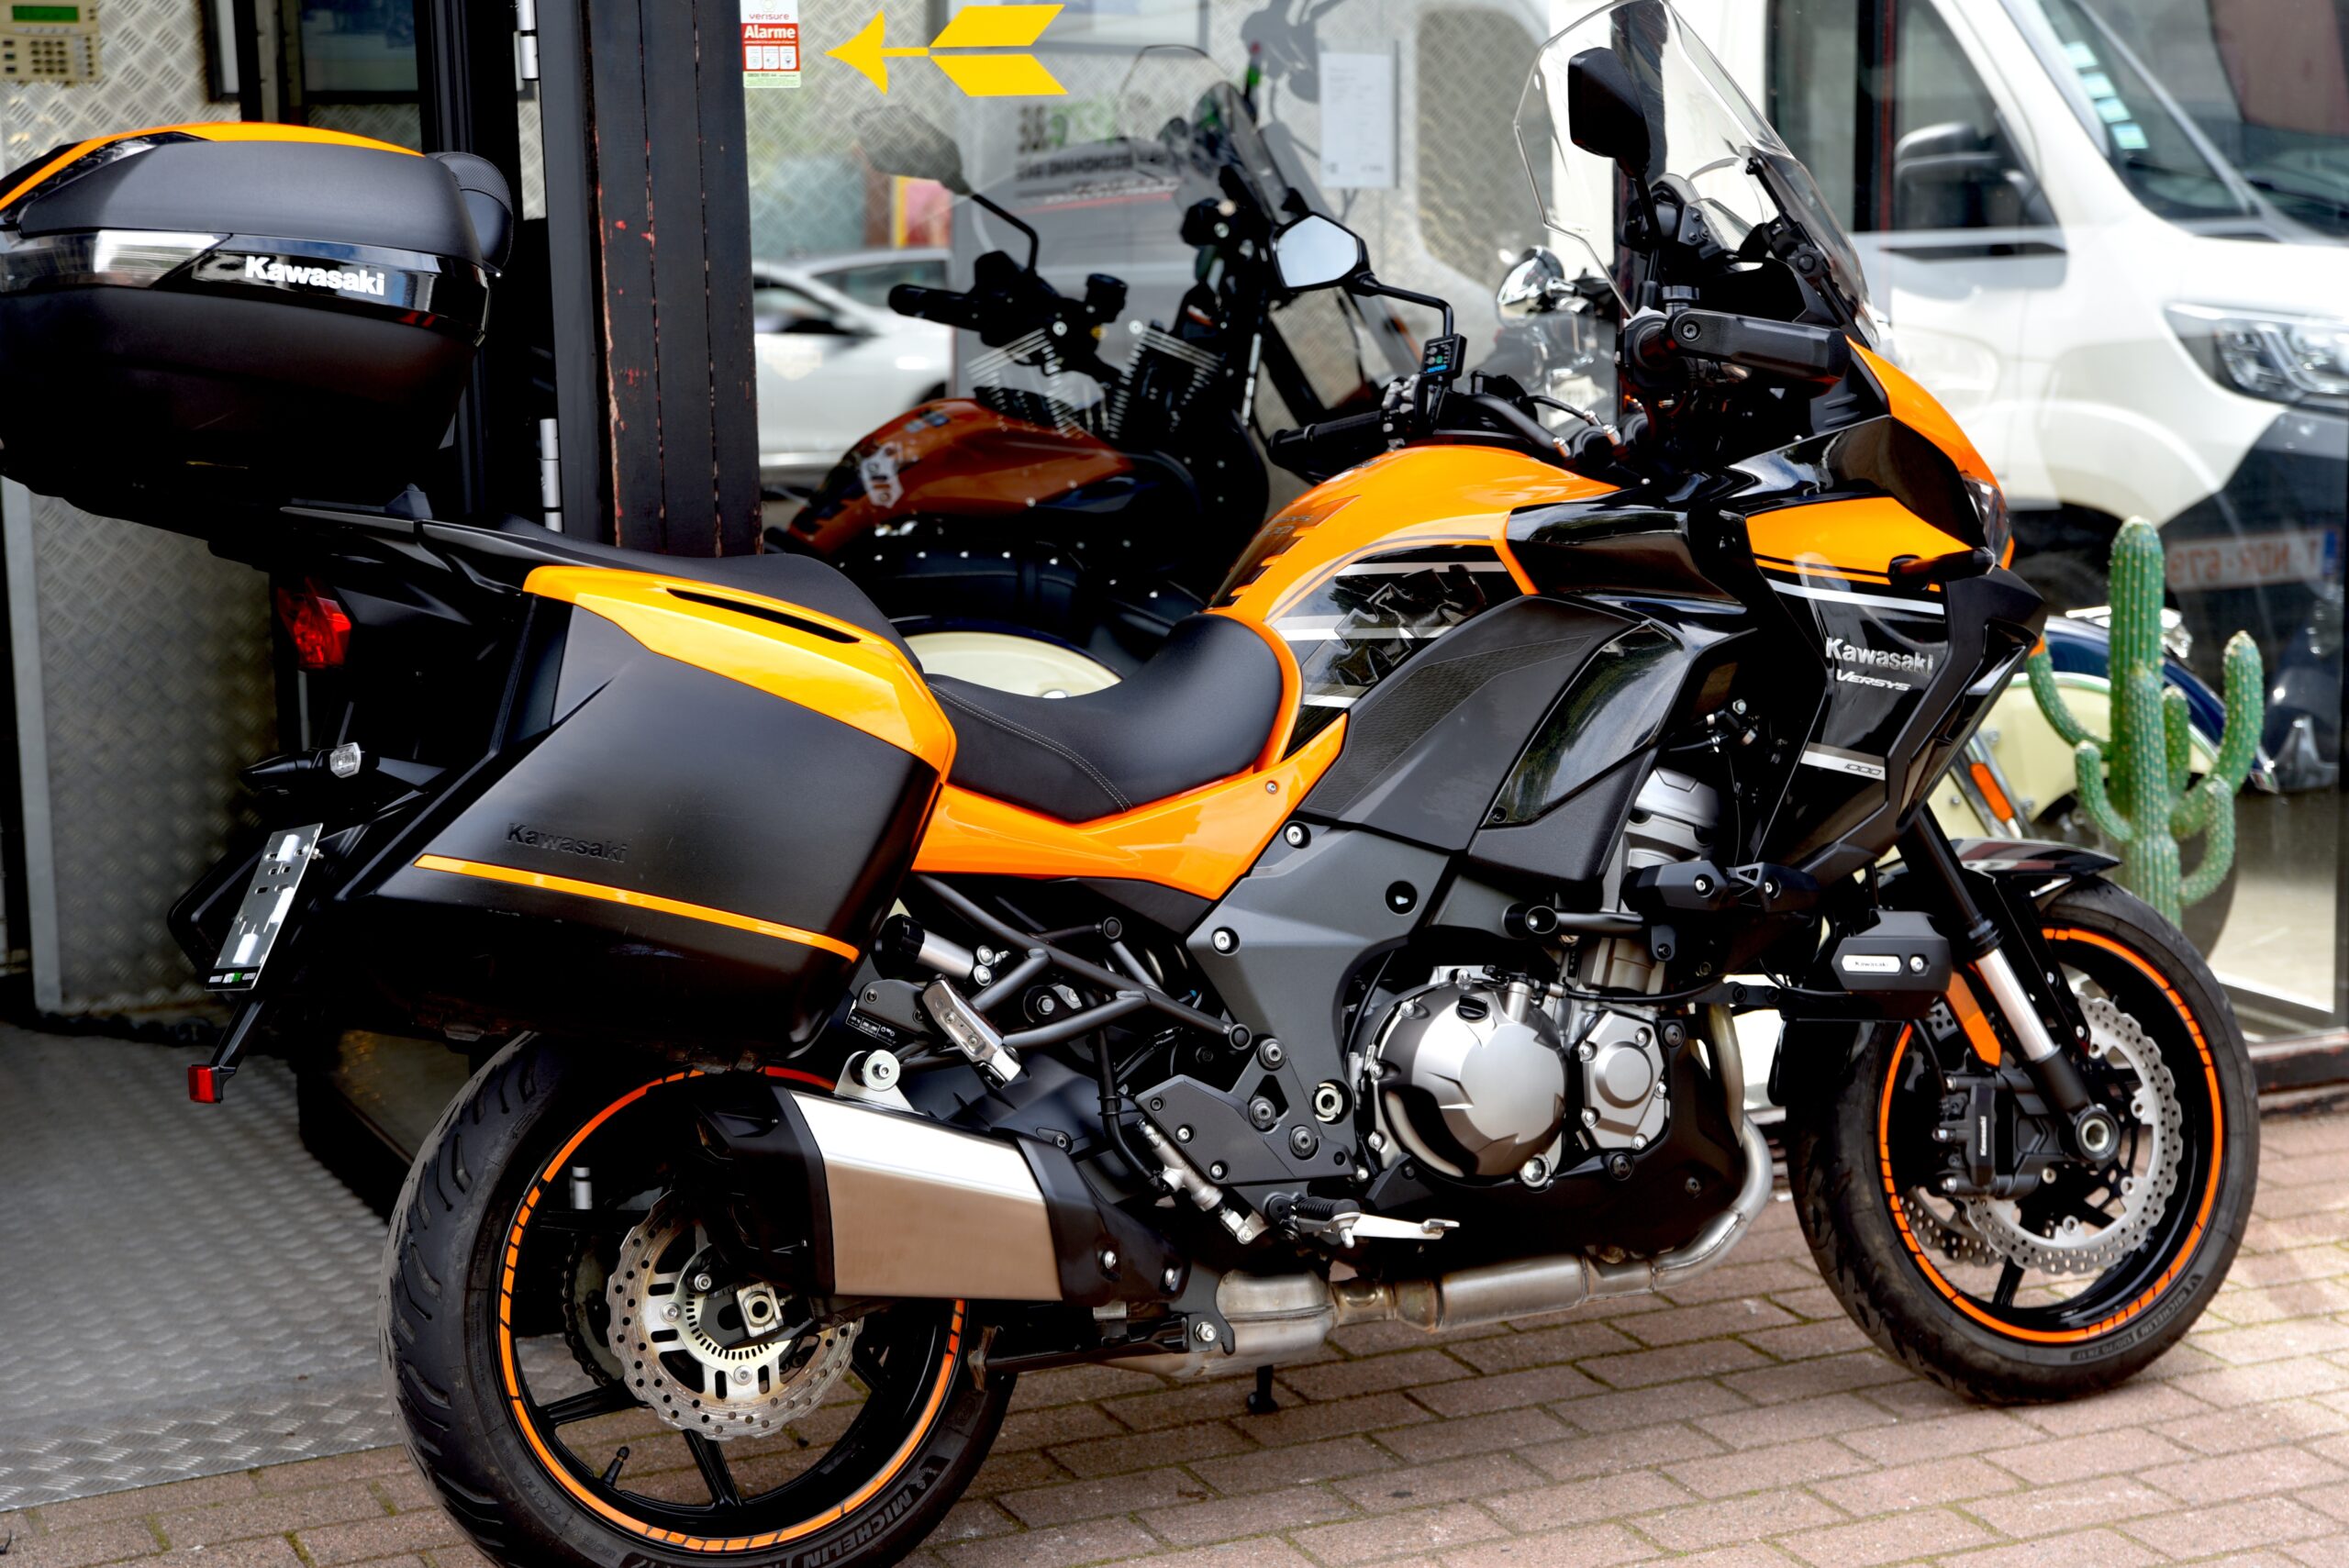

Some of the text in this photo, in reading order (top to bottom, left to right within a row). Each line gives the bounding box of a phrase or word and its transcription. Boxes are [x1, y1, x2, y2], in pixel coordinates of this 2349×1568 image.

[744, 24, 796, 39] Alarme
[244, 255, 386, 296] Kawasaki
[1825, 637, 1934, 675] Kawasaki
[1836, 668, 1912, 692] VERSYS
[1844, 762, 1883, 776] 1000
[506, 822, 628, 863] Kawasaki
[2140, 1292, 2188, 1336] MICHELIN
[803, 1489, 913, 1568] MICHELIN
